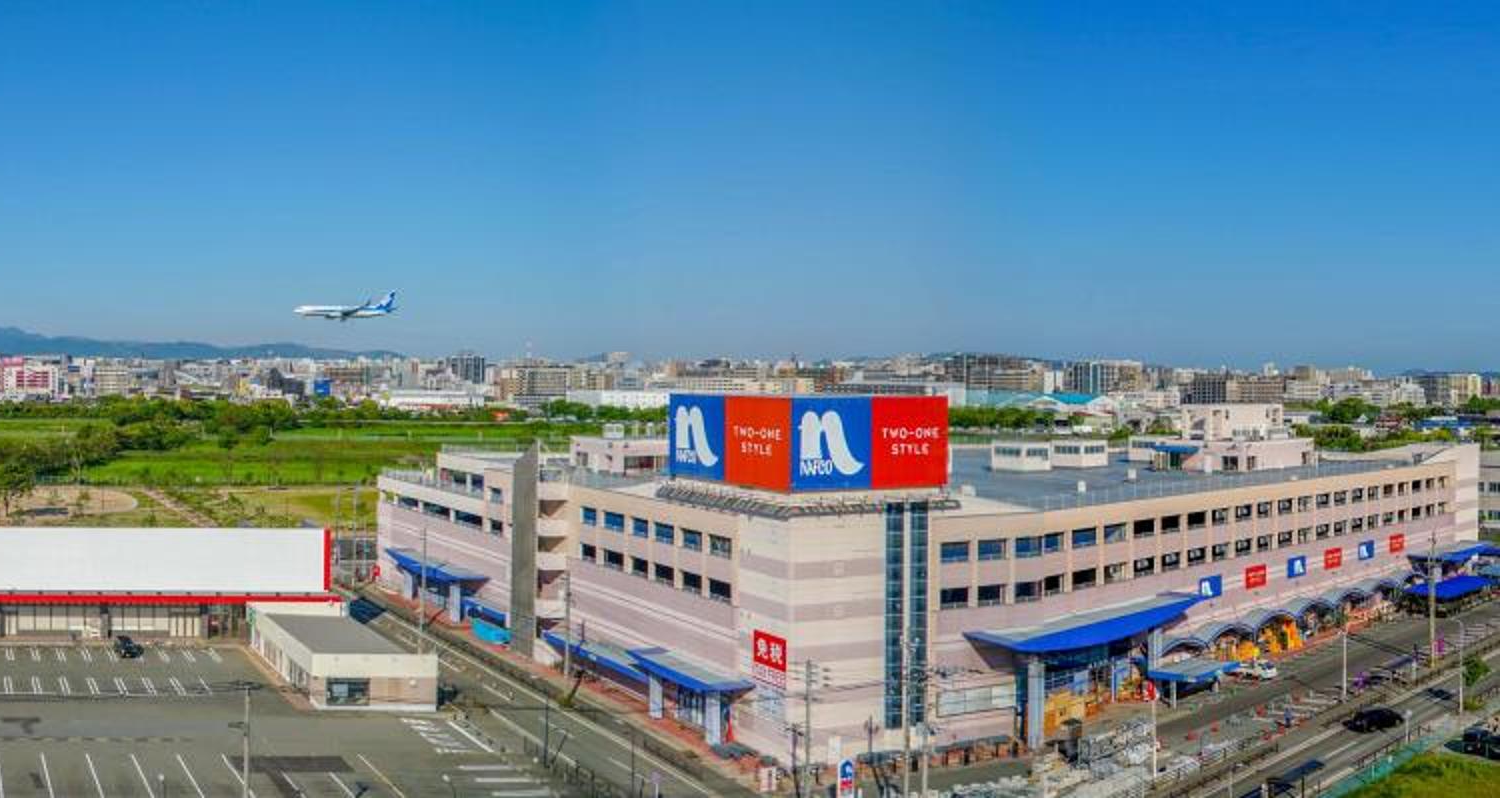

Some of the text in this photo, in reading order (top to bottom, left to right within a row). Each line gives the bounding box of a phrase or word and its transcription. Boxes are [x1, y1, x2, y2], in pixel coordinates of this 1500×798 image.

[733, 424, 782, 442] TWO-ONE
[882, 427, 940, 439] TWO-ONE
[741, 441, 773, 457] STYLE
[891, 443, 930, 456] STYLE
[800, 459, 834, 477] NAFCO
